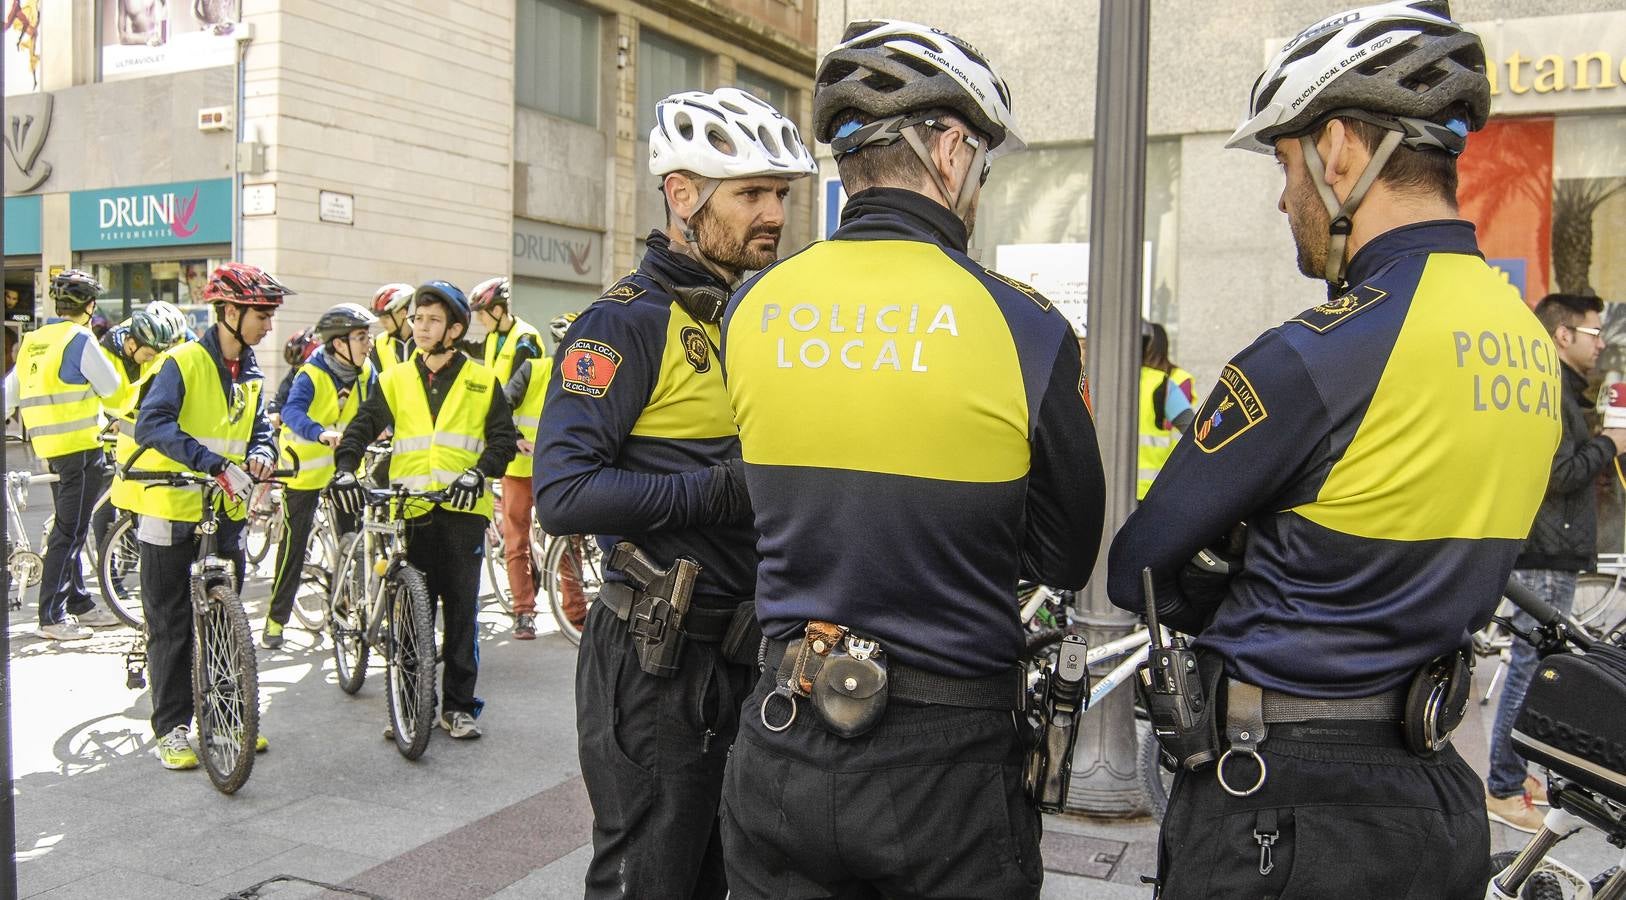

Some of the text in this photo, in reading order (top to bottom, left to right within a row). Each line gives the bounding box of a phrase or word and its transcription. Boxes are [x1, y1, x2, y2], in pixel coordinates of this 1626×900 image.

[115, 54, 165, 68] ULTRAVIOLET
[923, 50, 950, 68] POLICIA
[951, 66, 970, 84] LOCAL
[969, 82, 986, 101] ELCHE
[1486, 49, 1626, 97] tan
[1291, 49, 1367, 110] POLICIA LOCAL ELCHE
[99, 192, 175, 229] DRUNI
[101, 229, 172, 240] PERFUMERIES
[761, 303, 959, 337] POLICIA
[593, 344, 616, 361] LOCAL
[777, 337, 928, 372] LOCAL
[571, 384, 601, 394] CICLISTA
[1238, 385, 1260, 419] LOCAL
[1473, 375, 1558, 421] LOCAL
